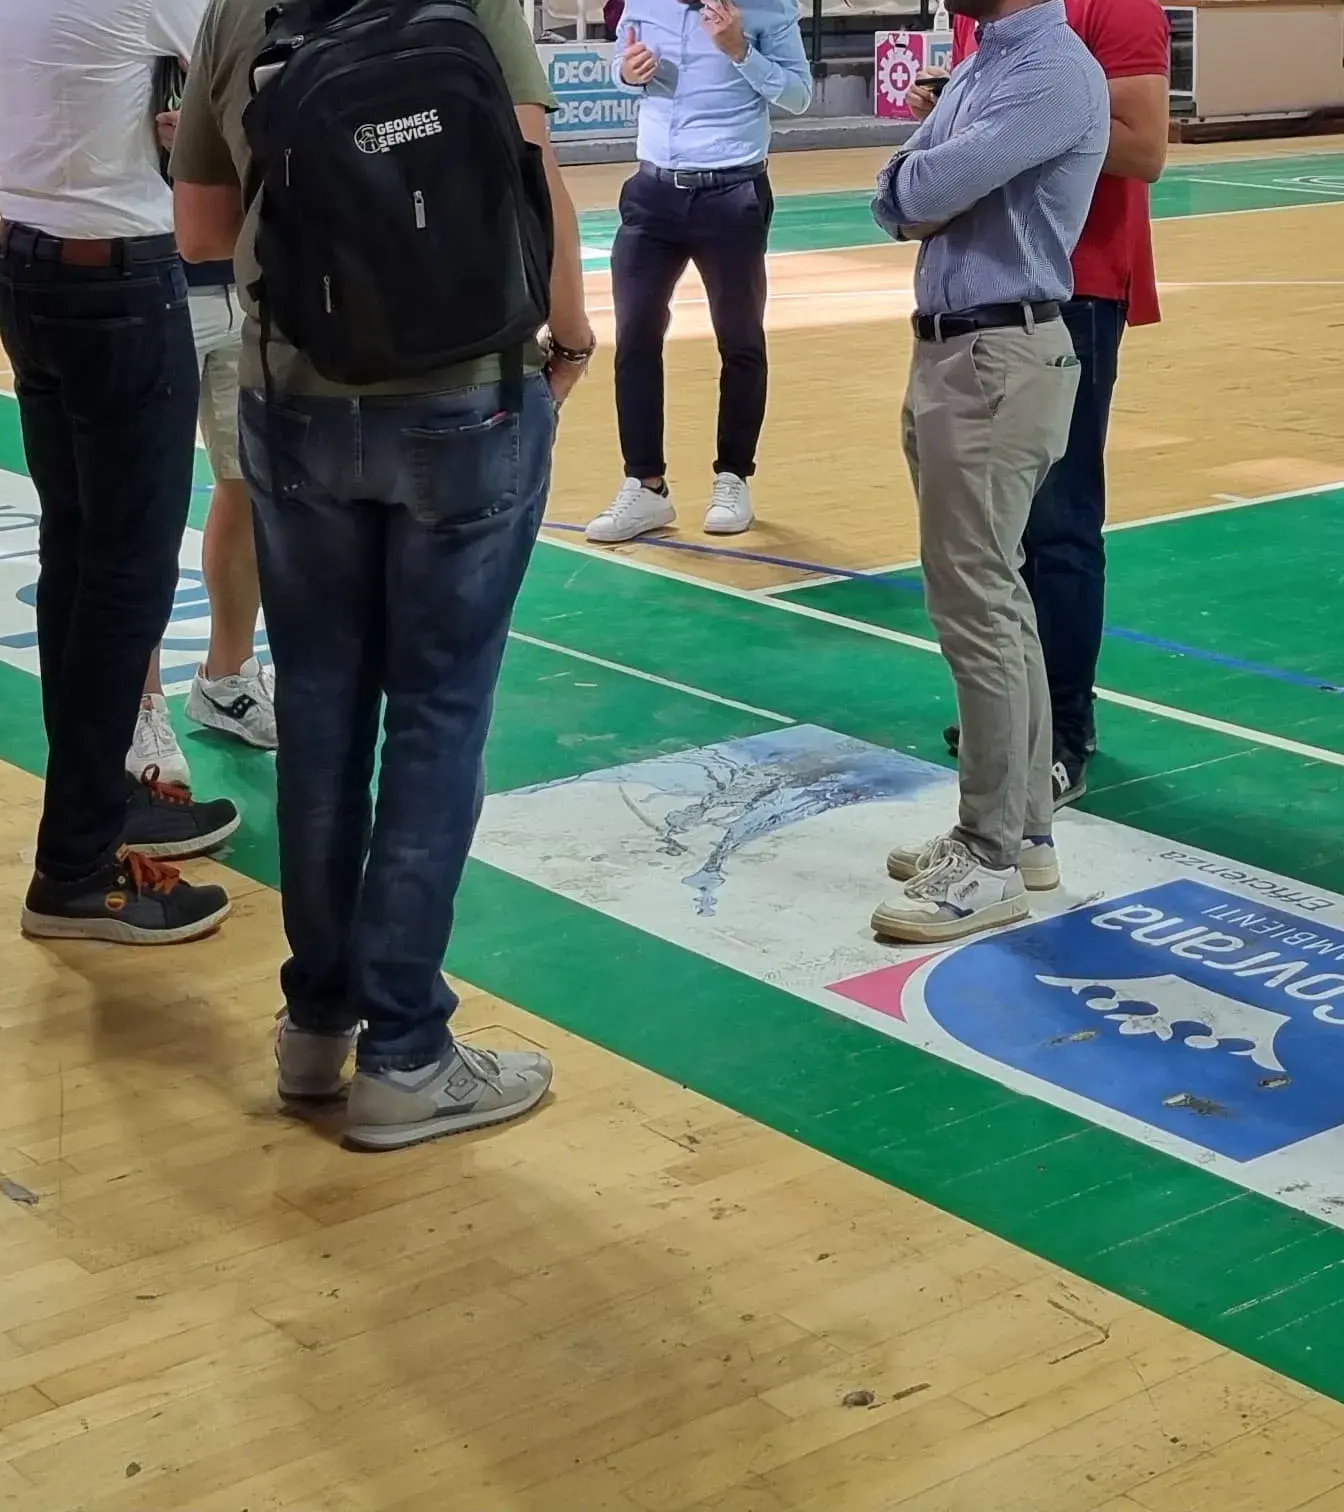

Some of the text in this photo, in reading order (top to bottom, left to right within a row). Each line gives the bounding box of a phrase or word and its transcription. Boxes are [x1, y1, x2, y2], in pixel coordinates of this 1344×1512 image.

[376, 109, 439, 135] GEOMECC
[554, 98, 639, 125] DECATHL
[378, 121, 443, 148] SERVICES
[1156, 846, 1337, 915] Efficienza
